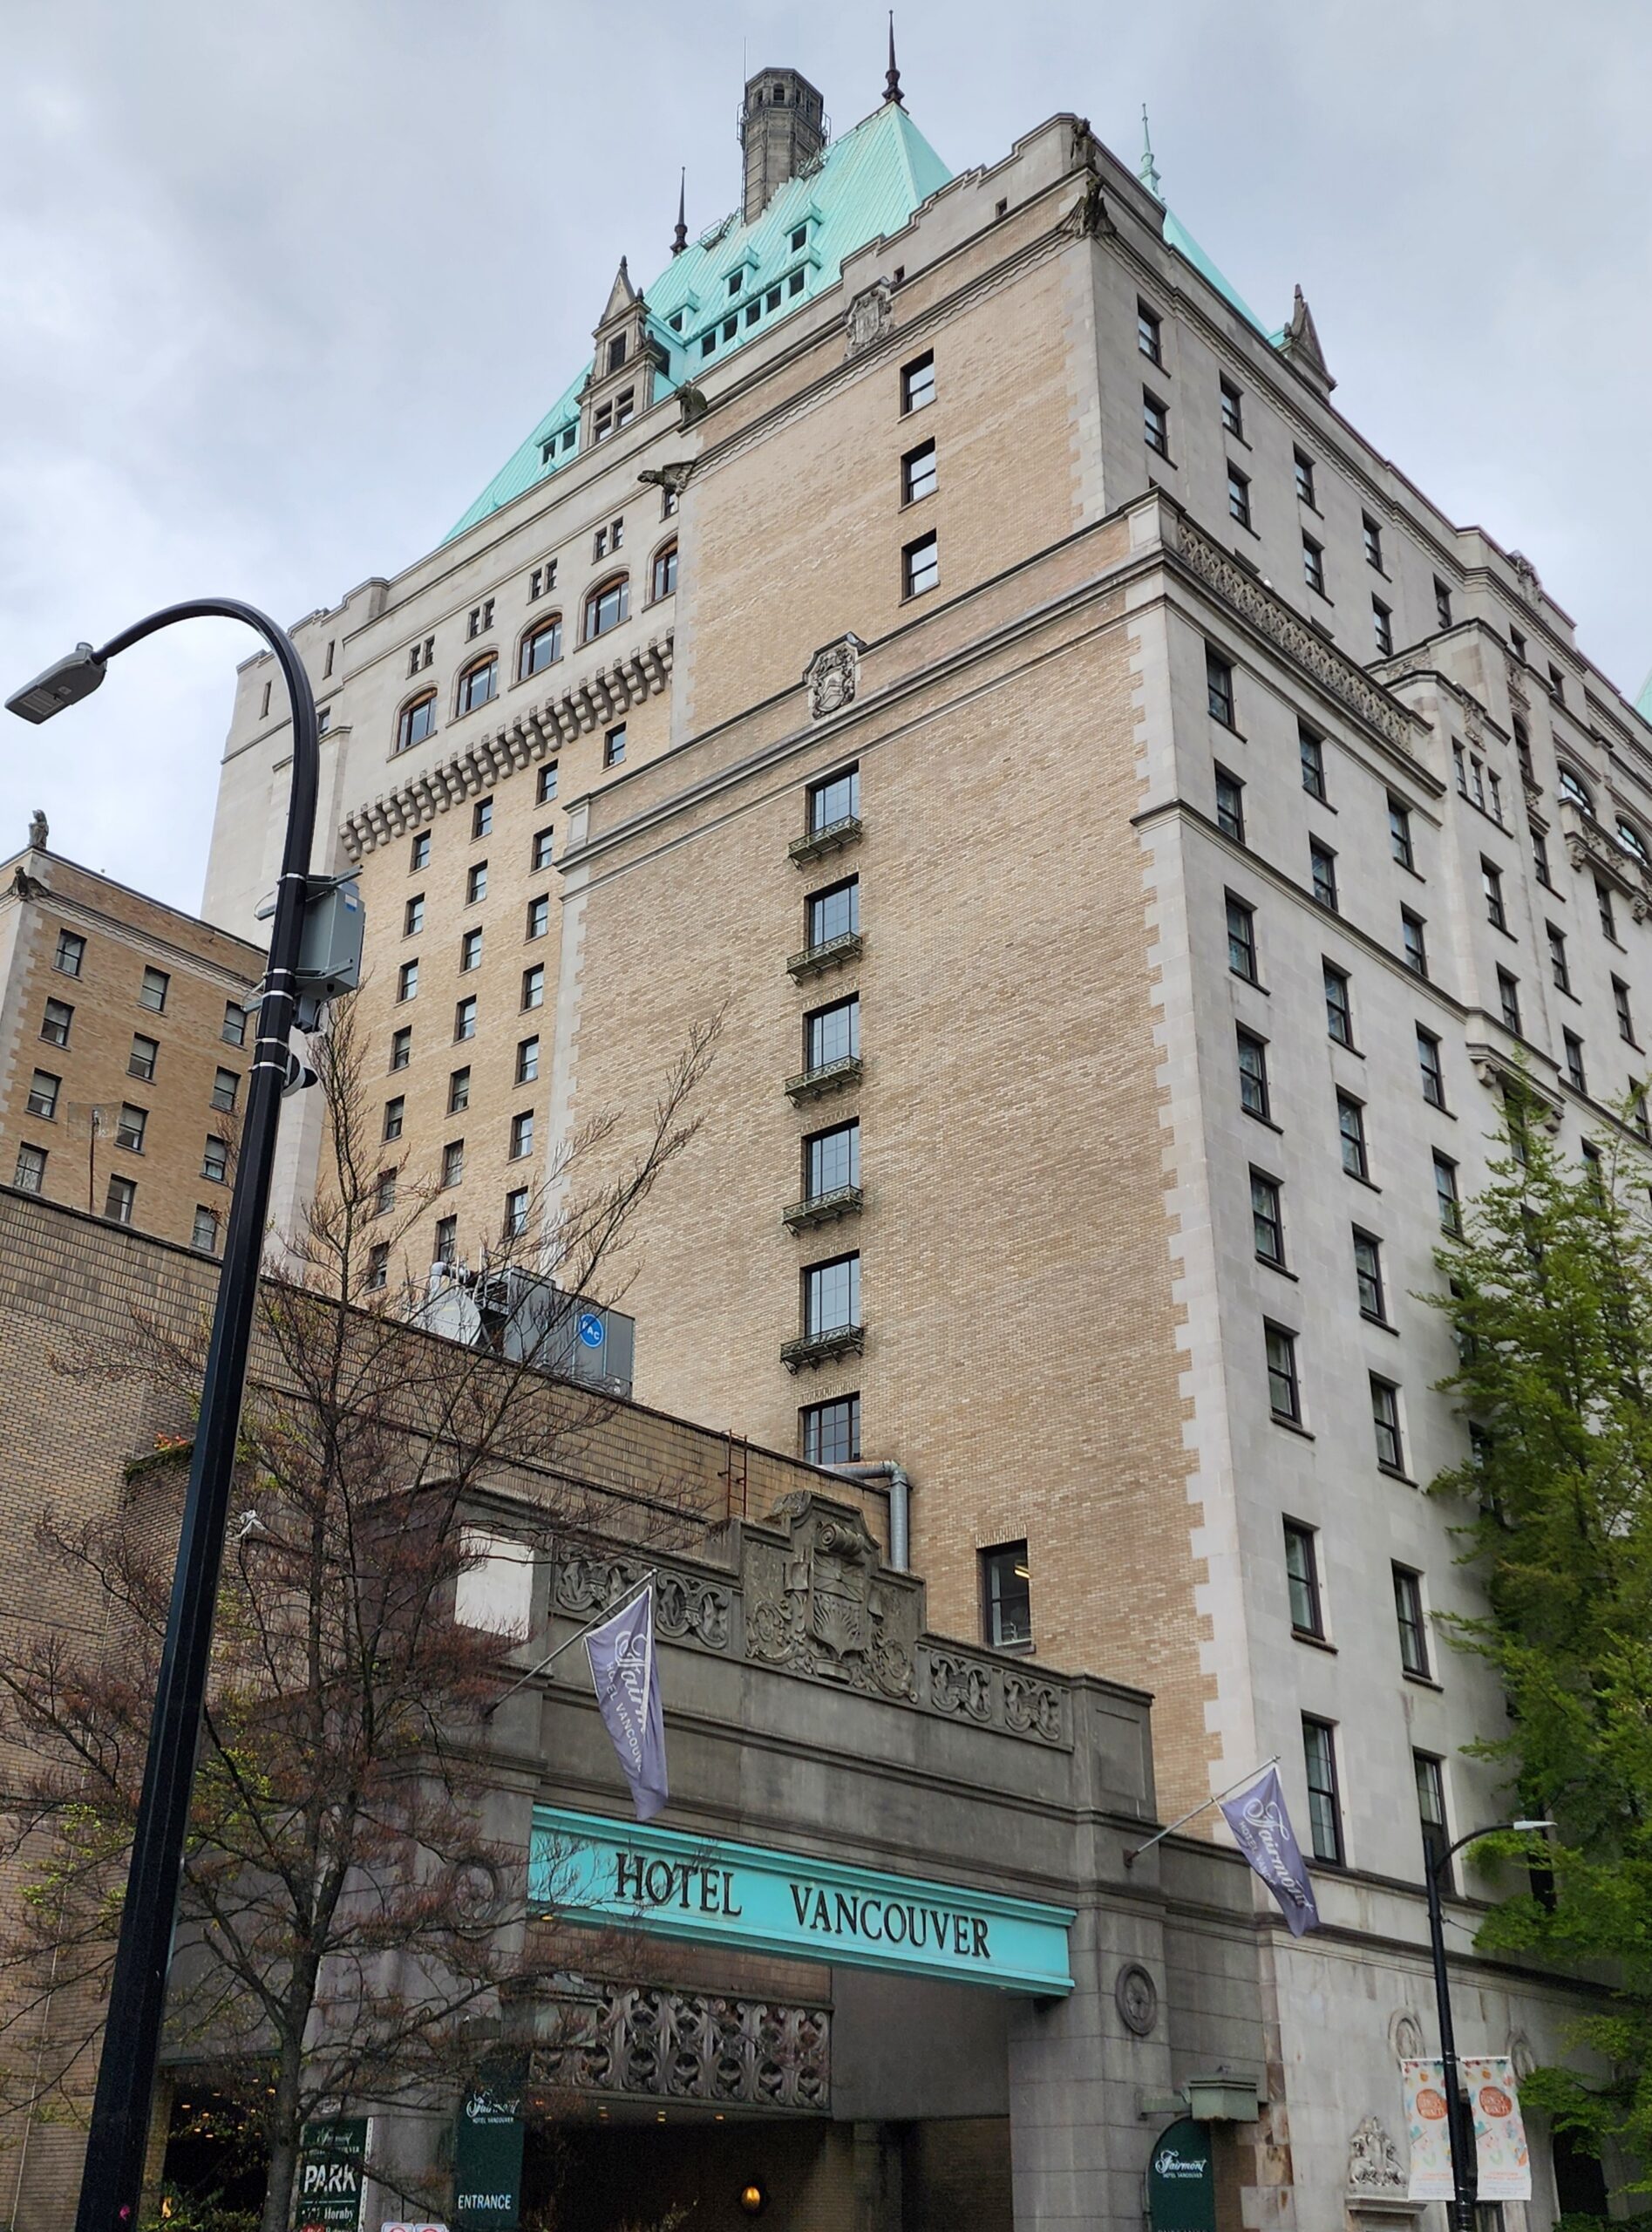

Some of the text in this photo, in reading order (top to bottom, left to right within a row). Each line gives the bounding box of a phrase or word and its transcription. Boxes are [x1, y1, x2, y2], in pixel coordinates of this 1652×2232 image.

[615, 1702, 642, 1773] VANCOUV
[1239, 1820, 1258, 1855] HOTEL
[1242, 1798, 1315, 1913] Fairmont
[615, 1851, 991, 1959] HOTEL VANCOUVER
[1155, 2149, 1207, 2174] Fairmont
[303, 2163, 357, 2193] PARK
[323, 2206, 354, 2222] Hornby
[458, 2194, 512, 2210] ENTRANCE
